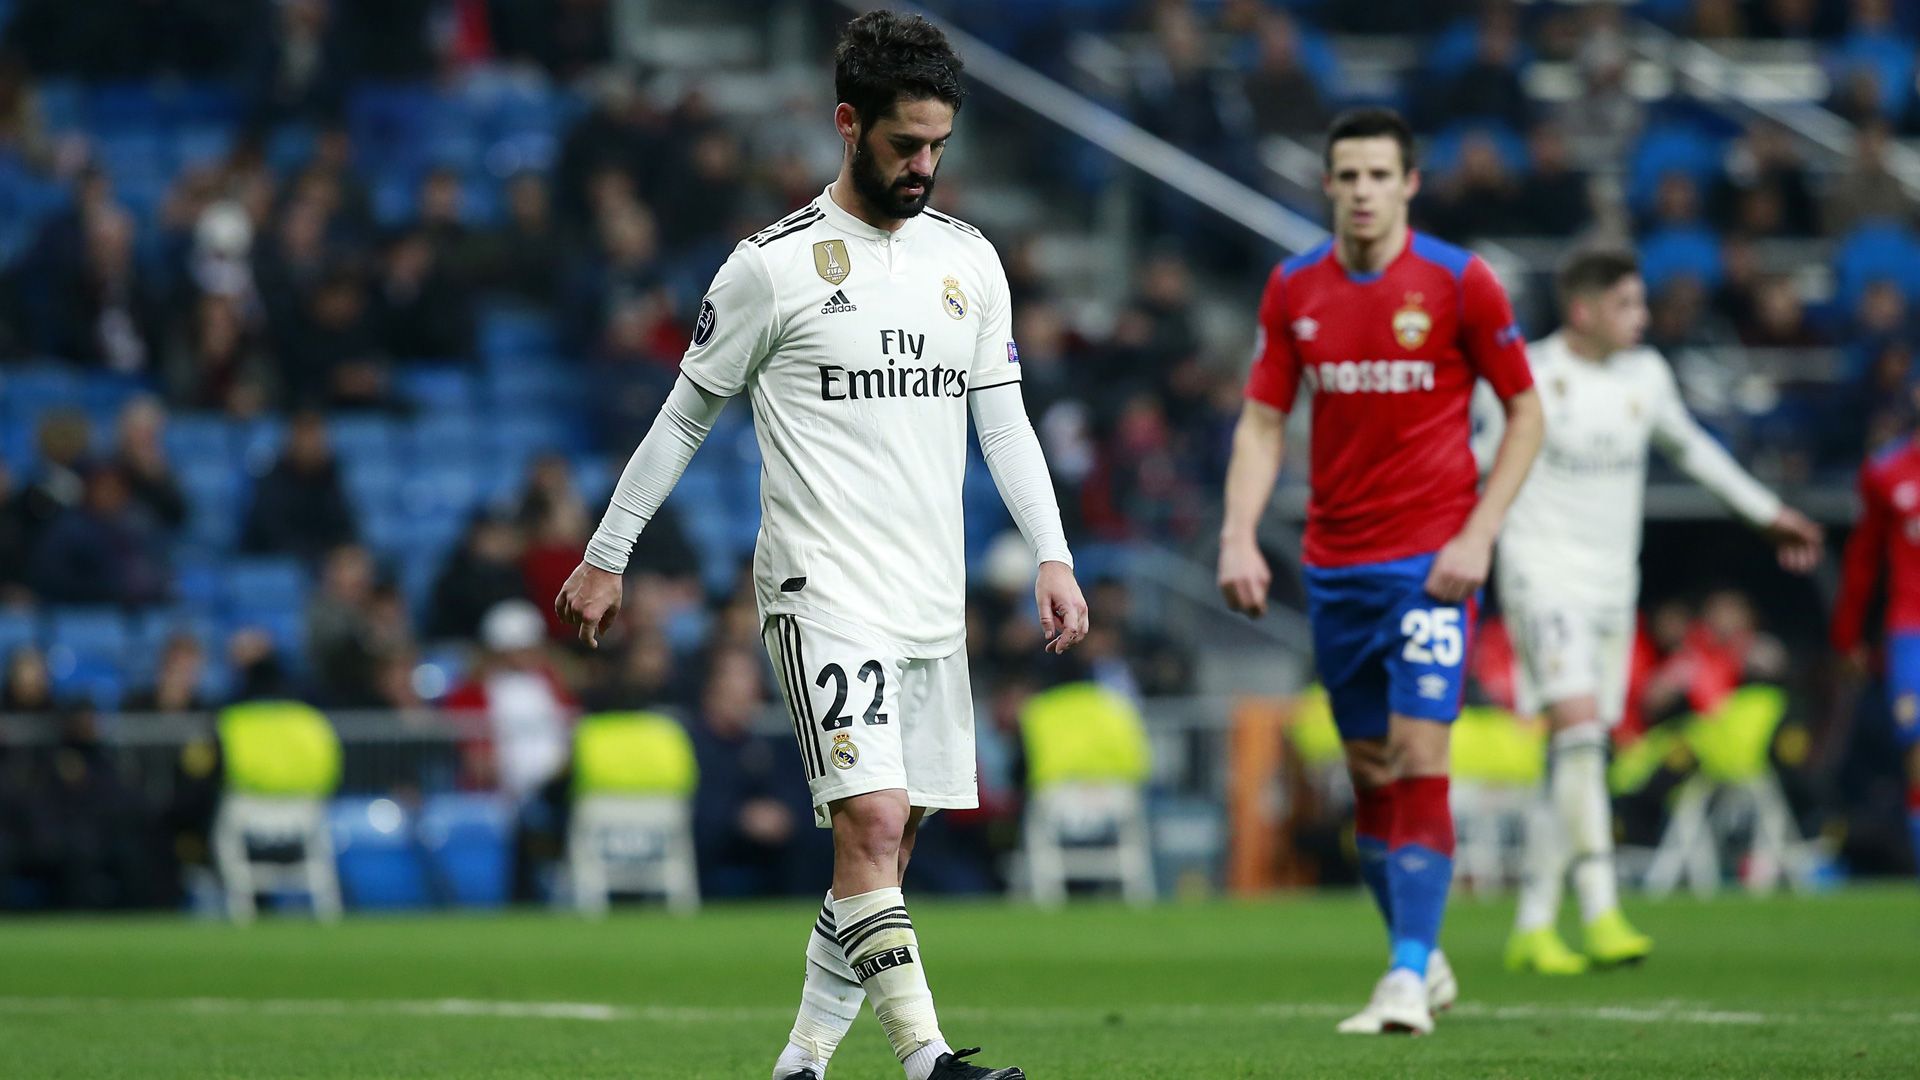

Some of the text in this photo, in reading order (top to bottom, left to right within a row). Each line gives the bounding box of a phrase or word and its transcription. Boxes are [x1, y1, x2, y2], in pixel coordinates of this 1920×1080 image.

[826, 267, 843, 276] FIFA
[821, 304, 857, 315] adidas
[880, 329, 925, 360] Fly
[818, 358, 967, 401] Emirates
[1320, 359, 1435, 394] ROSSETI
[1401, 607, 1463, 668] 25
[815, 659, 888, 732] 22
